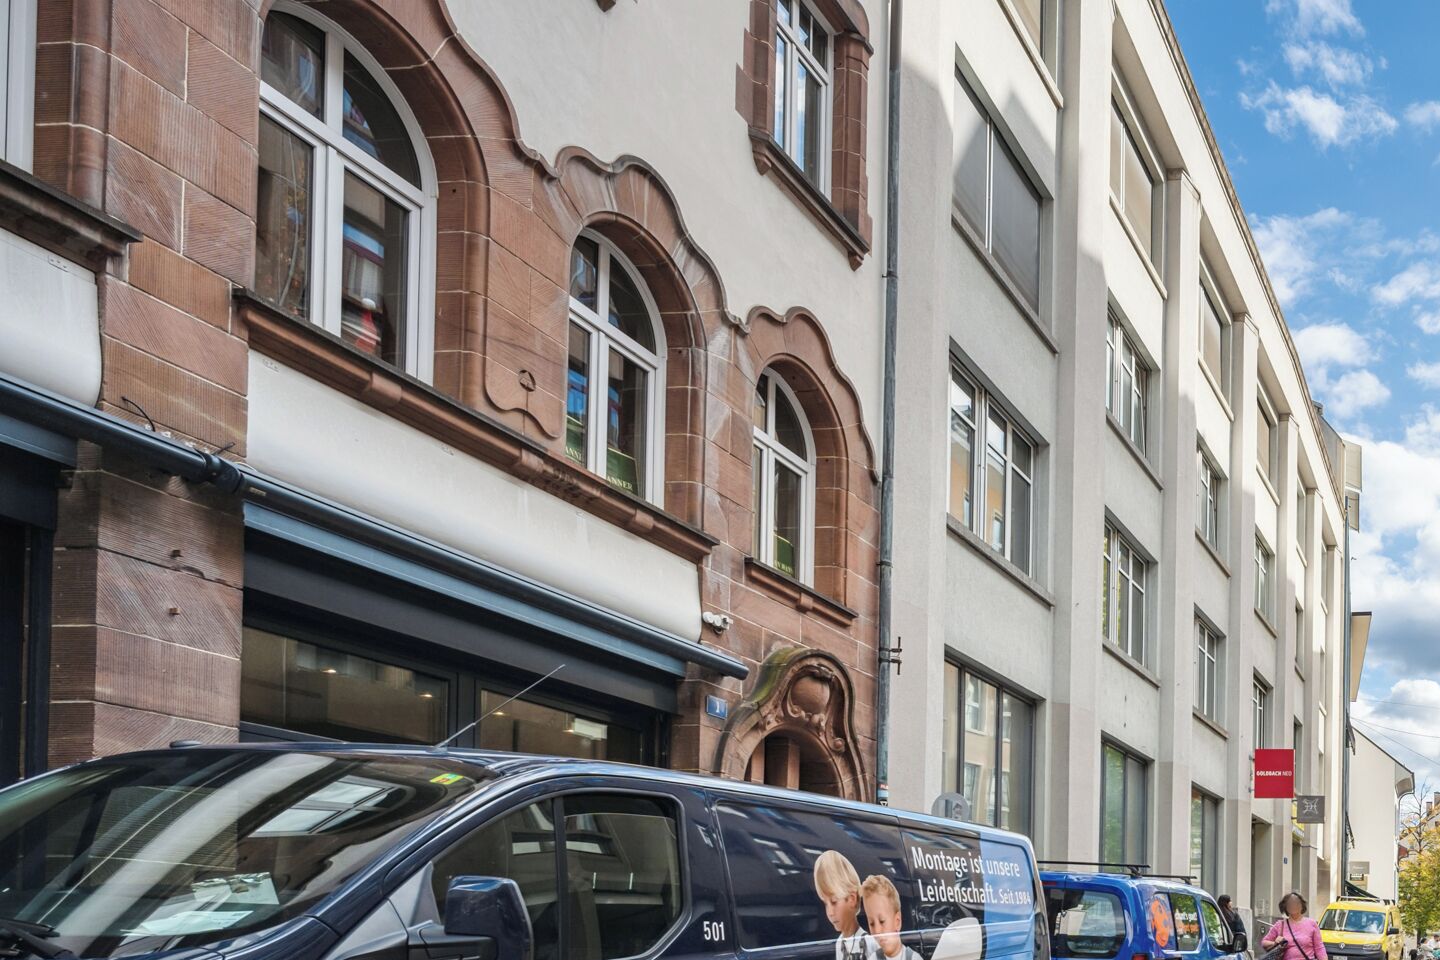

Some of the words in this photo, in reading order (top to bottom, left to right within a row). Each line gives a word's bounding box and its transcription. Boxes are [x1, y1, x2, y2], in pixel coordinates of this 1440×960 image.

[911, 846, 969, 878] Montage
[968, 852, 985, 874] ist
[986, 859, 1021, 878] unsere
[918, 878, 998, 904] Leidenschaft.
[999, 888, 1015, 905] Seit
[1014, 890, 1032, 905] 1984
[703, 920, 726, 942] 501
